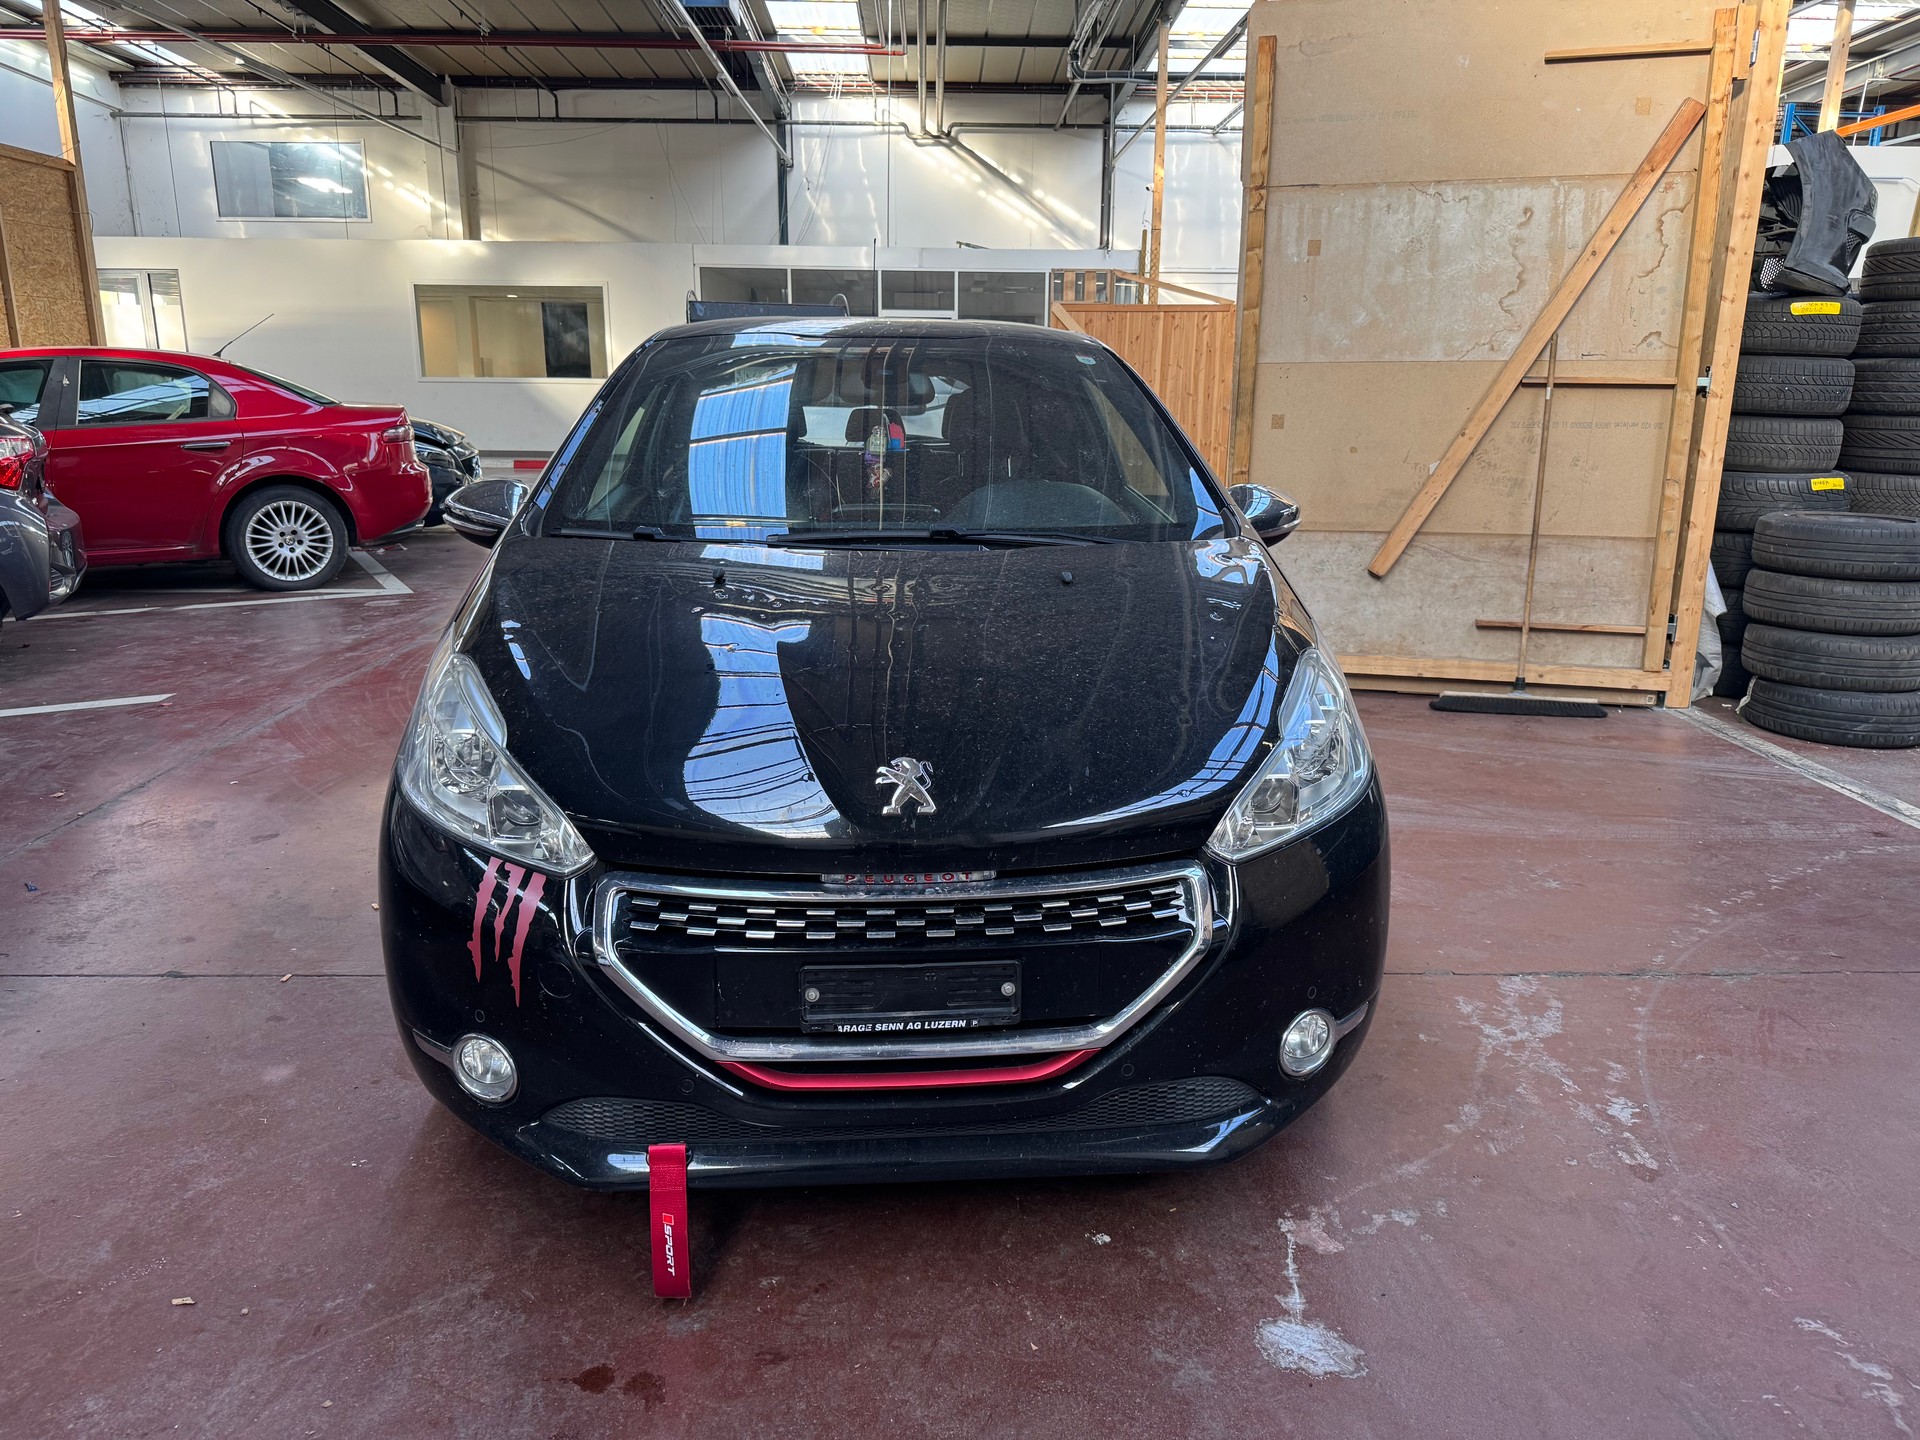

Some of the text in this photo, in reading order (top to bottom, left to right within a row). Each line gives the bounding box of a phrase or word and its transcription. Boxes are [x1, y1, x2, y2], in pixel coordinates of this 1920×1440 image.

[845, 871, 972, 884] PEUGEOT
[837, 1024, 872, 1033] ARAGE
[875, 1022, 904, 1031] SENN
[906, 1022, 921, 1030] AG
[924, 1020, 967, 1029] LUZERN
[664, 1224, 675, 1276] SPORT
